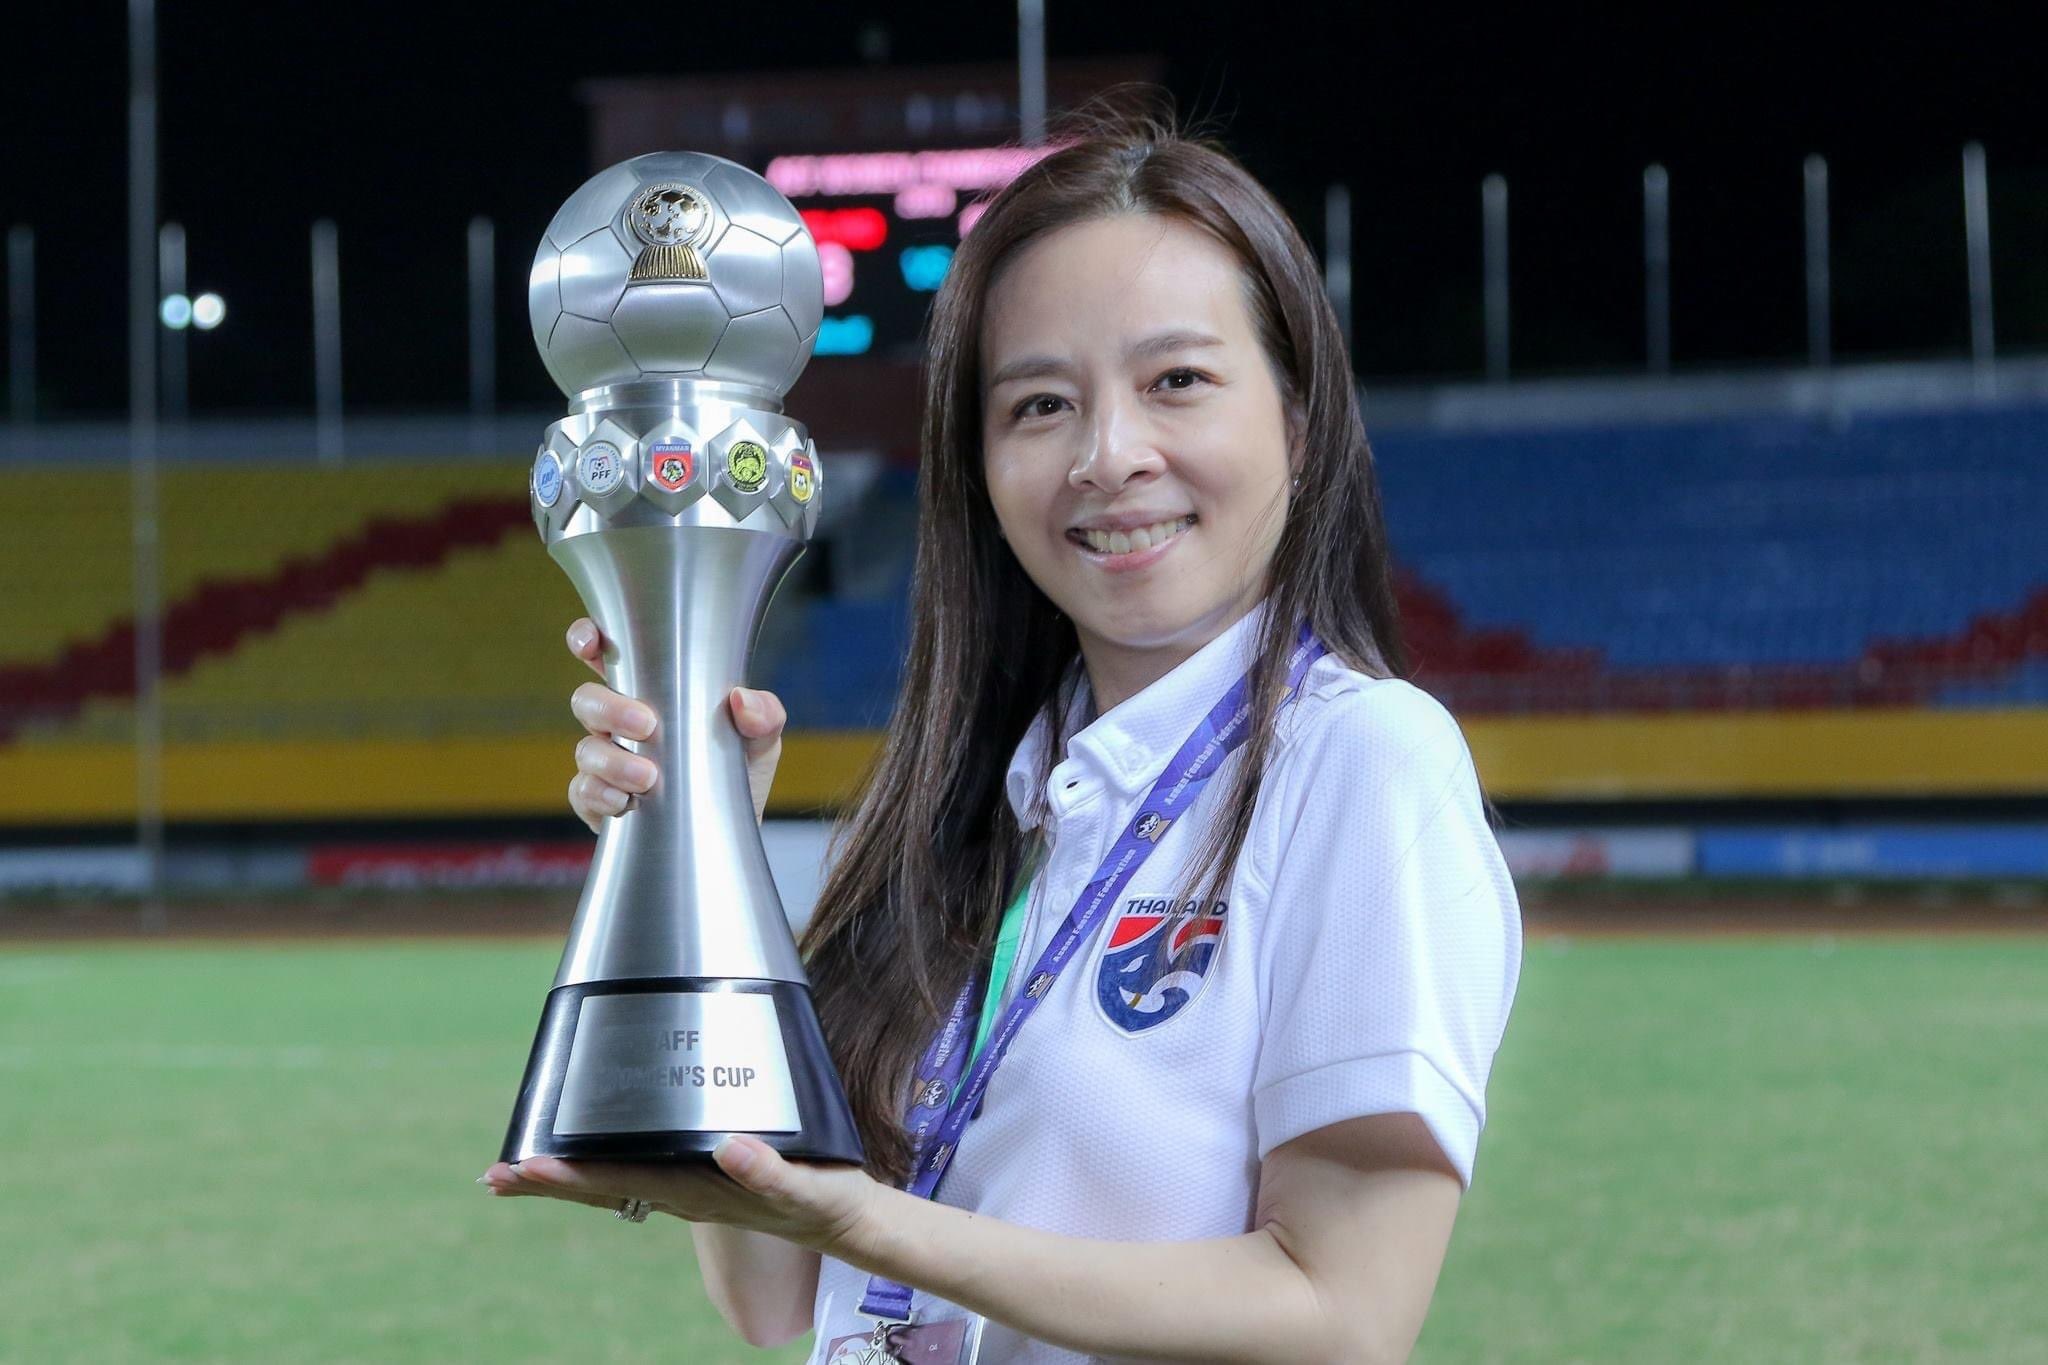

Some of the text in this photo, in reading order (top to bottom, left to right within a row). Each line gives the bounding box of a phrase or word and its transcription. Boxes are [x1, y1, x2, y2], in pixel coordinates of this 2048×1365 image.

[591, 470, 611, 481] PFF
[1183, 741, 1217, 779] Football
[1071, 895, 1102, 936] Football
[1126, 900, 1227, 915] THAIAD
[658, 1030, 699, 1051] AFF
[713, 1066, 756, 1087] CUP
